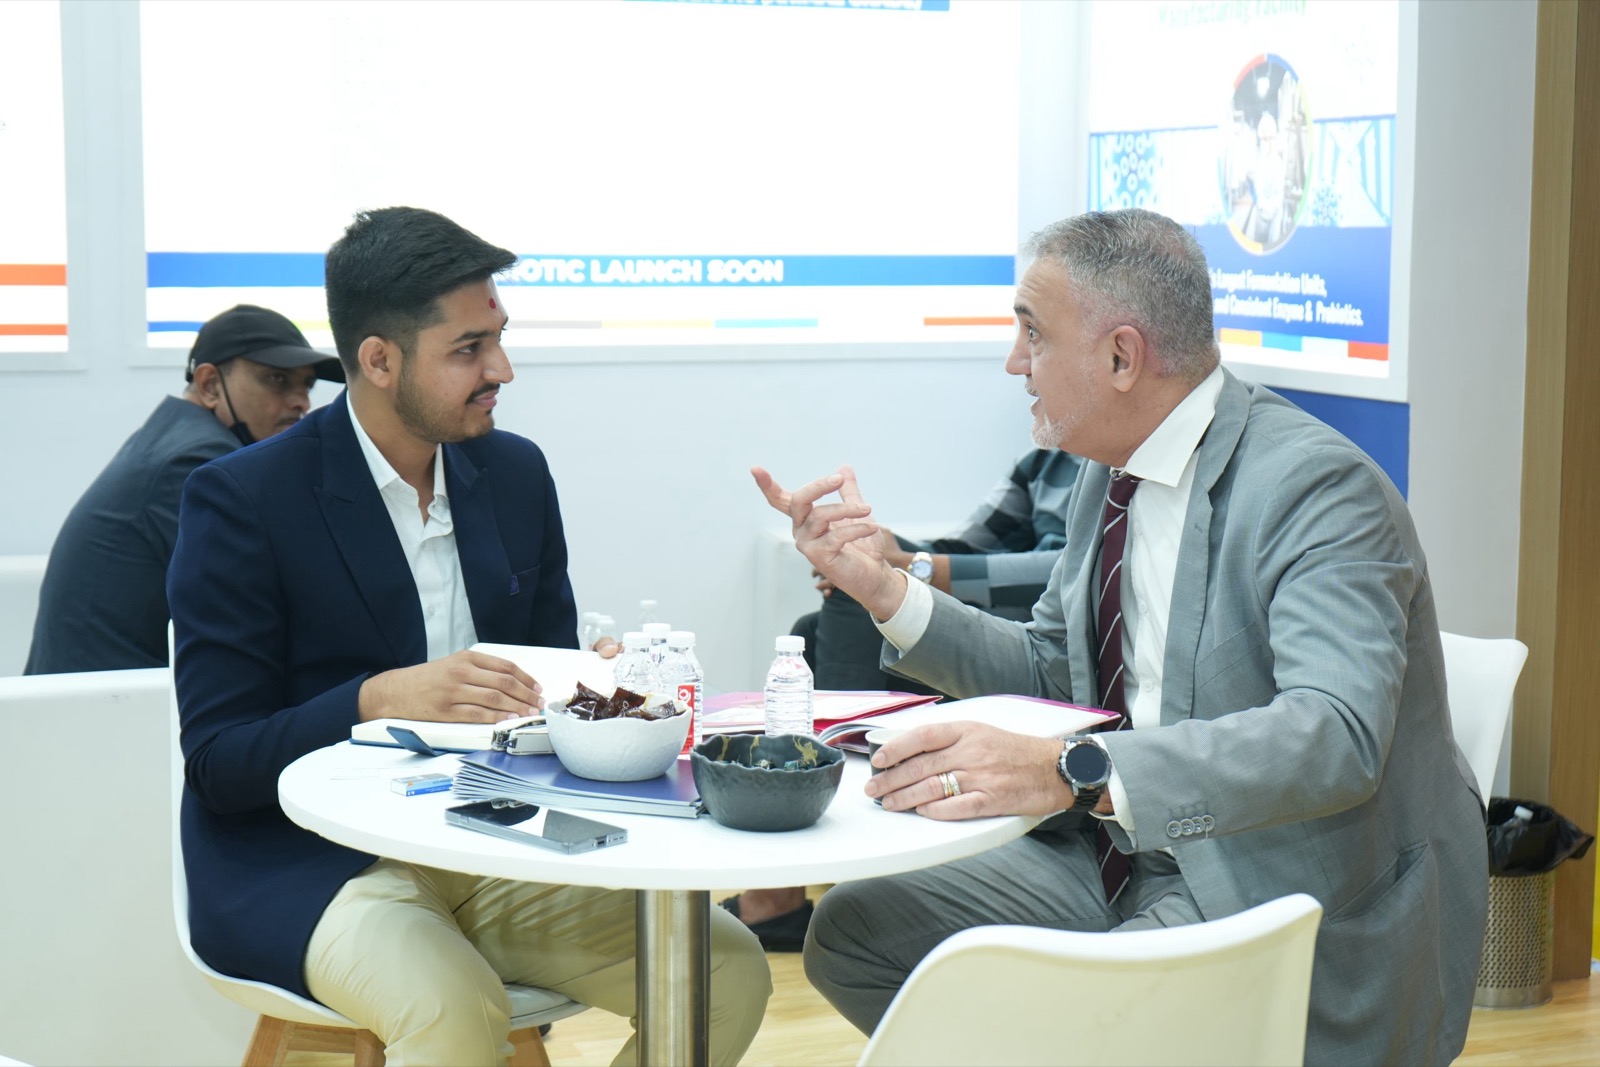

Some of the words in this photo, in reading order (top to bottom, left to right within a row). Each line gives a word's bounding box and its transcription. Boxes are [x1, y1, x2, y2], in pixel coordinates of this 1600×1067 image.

[591, 258, 703, 283] LAUNCH
[707, 258, 784, 283] SOON
[1273, 296, 1304, 323] Enzyme
[1305, 300, 1313, 322] &
